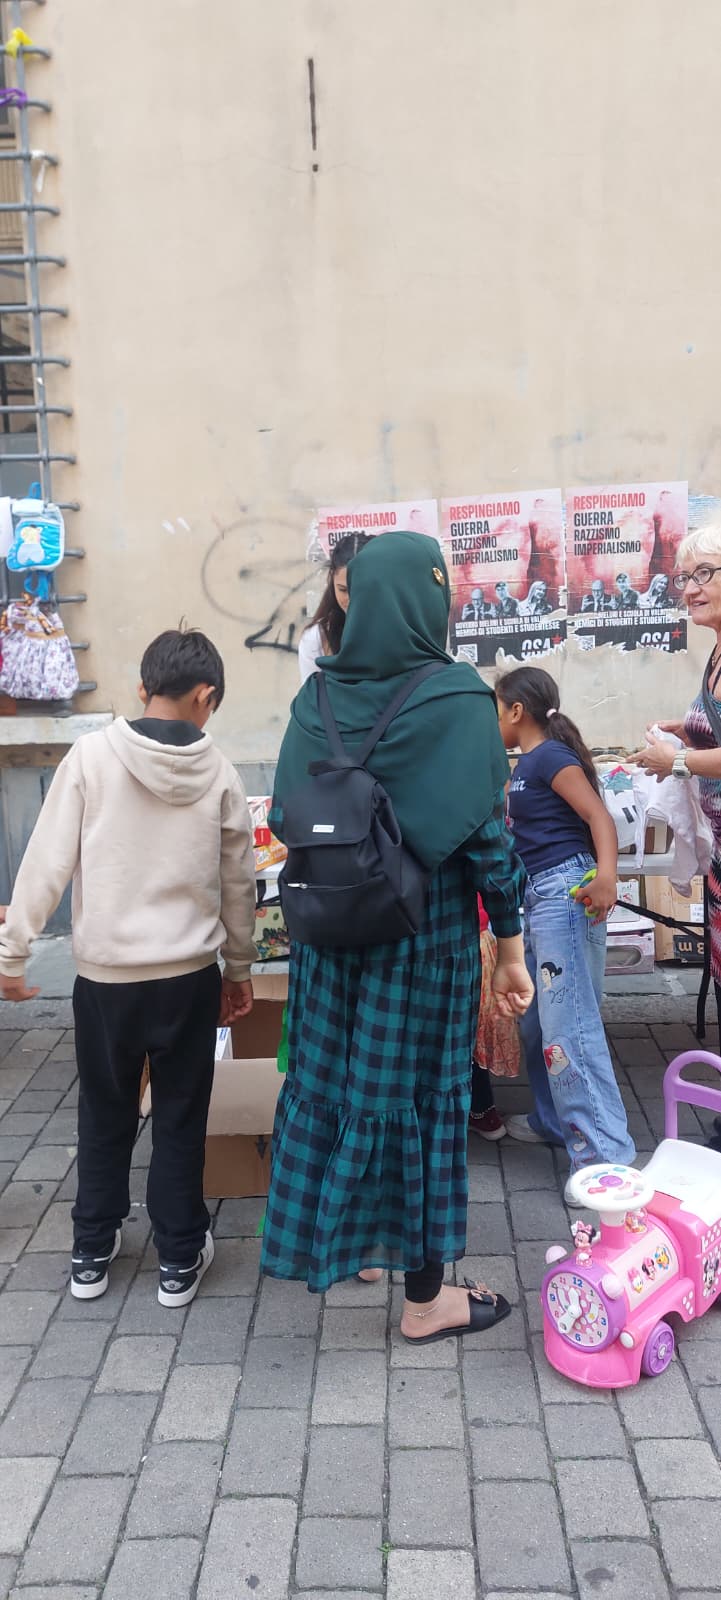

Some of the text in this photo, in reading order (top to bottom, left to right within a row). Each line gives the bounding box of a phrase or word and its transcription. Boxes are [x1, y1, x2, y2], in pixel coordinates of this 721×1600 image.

[573, 492, 646, 511] RESPINGIAMO
[449, 501, 520, 520] RESPINGIAMO
[326, 511, 397, 529] RESPINGIAMO
[573, 511, 614, 527] GUERRA
[450, 520, 490, 537] GUERRA
[574, 527, 621, 541] RAZZISMO
[451, 536, 497, 552] RAZZISMO
[574, 540, 641, 556] IMPERIALISMO
[452, 548, 519, 566] IMPERIALISMO
[478, 627, 485, 636] DI
[485, 625, 514, 635] STUDENTI
[514, 624, 519, 633] E
[519, 620, 561, 632] STUDENTESSE
[597, 618, 604, 627] DI
[604, 617, 633, 627] STUDENTI
[634, 616, 639, 625] E
[678, 942, 693, 952] m
[573, 1277, 583, 1287] 12
[575, 1333, 581, 1341] 6
